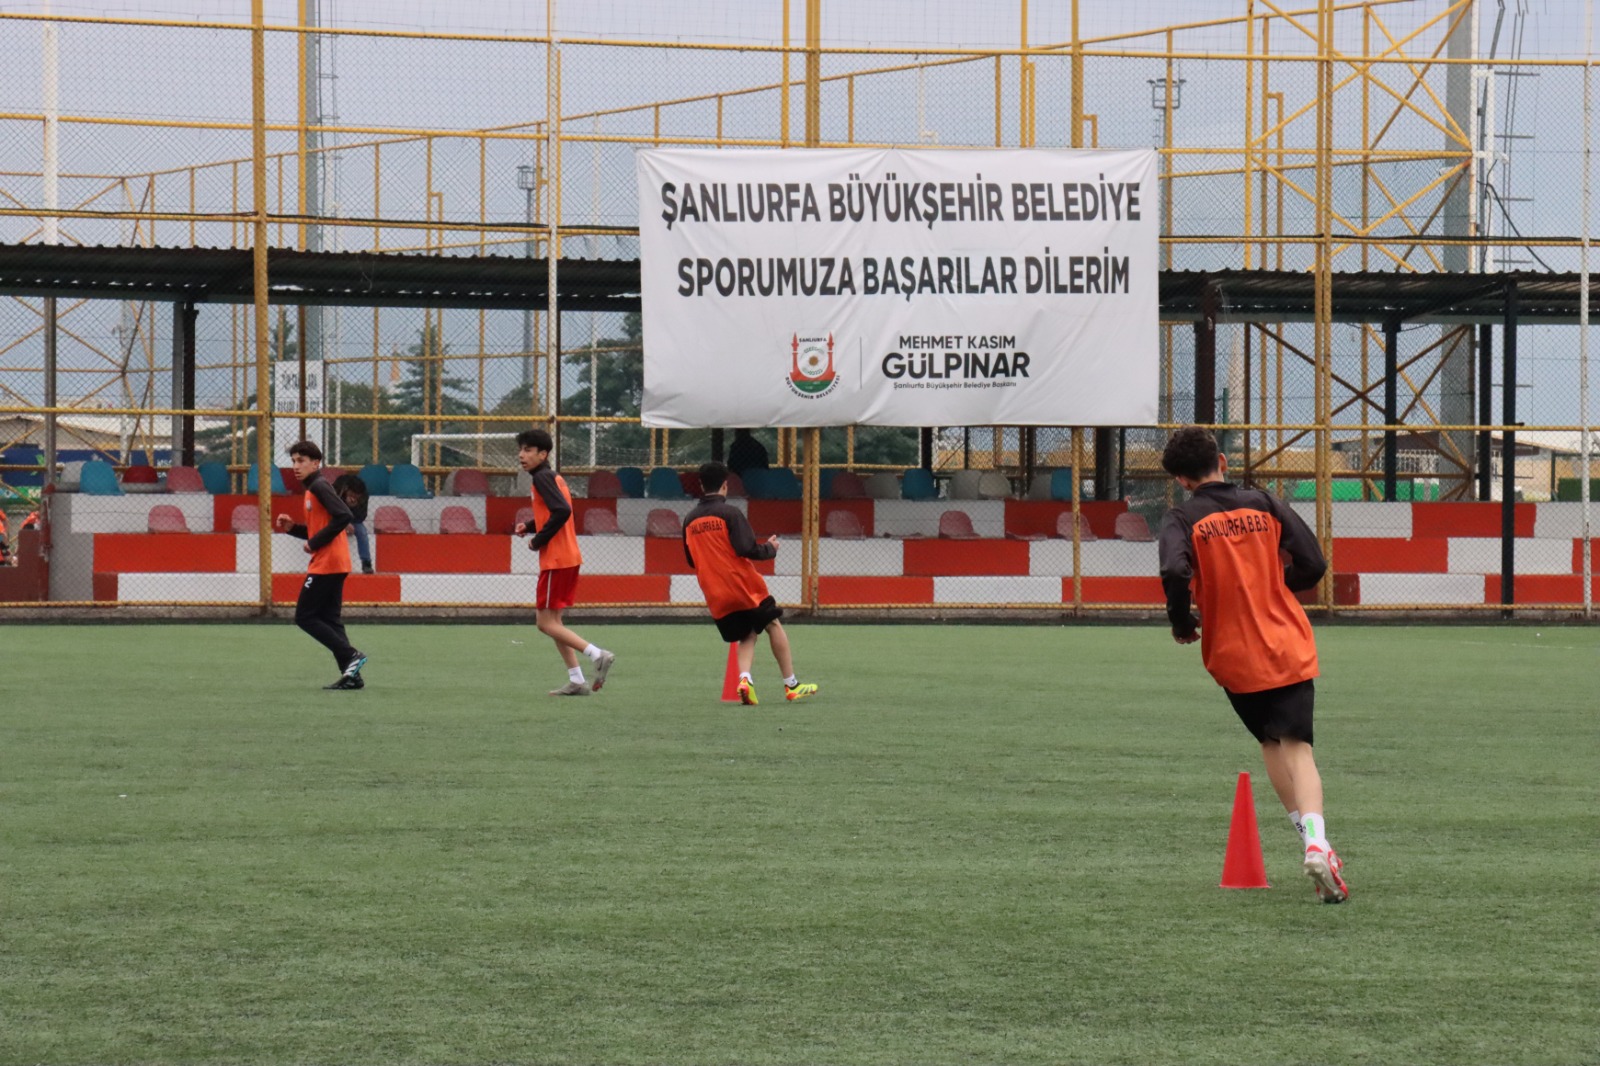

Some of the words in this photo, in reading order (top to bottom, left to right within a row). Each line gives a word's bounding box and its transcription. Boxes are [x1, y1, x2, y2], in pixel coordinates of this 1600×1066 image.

[661, 181, 822, 231] ŞANLIURFA
[827, 172, 1005, 231] BÜYÜKŞEHİR
[1011, 172, 1141, 222] BELEDİYE
[677, 256, 857, 298] SPORUMUZA
[862, 256, 1018, 303] BAŞARILAR
[1024, 246, 1130, 294] DİLERİM
[899, 335, 964, 349] MEHMET
[967, 335, 1016, 349] KASIM
[881, 351, 1031, 380] GÜLPINAR
[893, 381, 925, 391] Şanlıurfa
[926, 381, 962, 391] Büyükşehir
[963, 381, 991, 390] Belediye
[992, 380, 1017, 390] Başkanı
